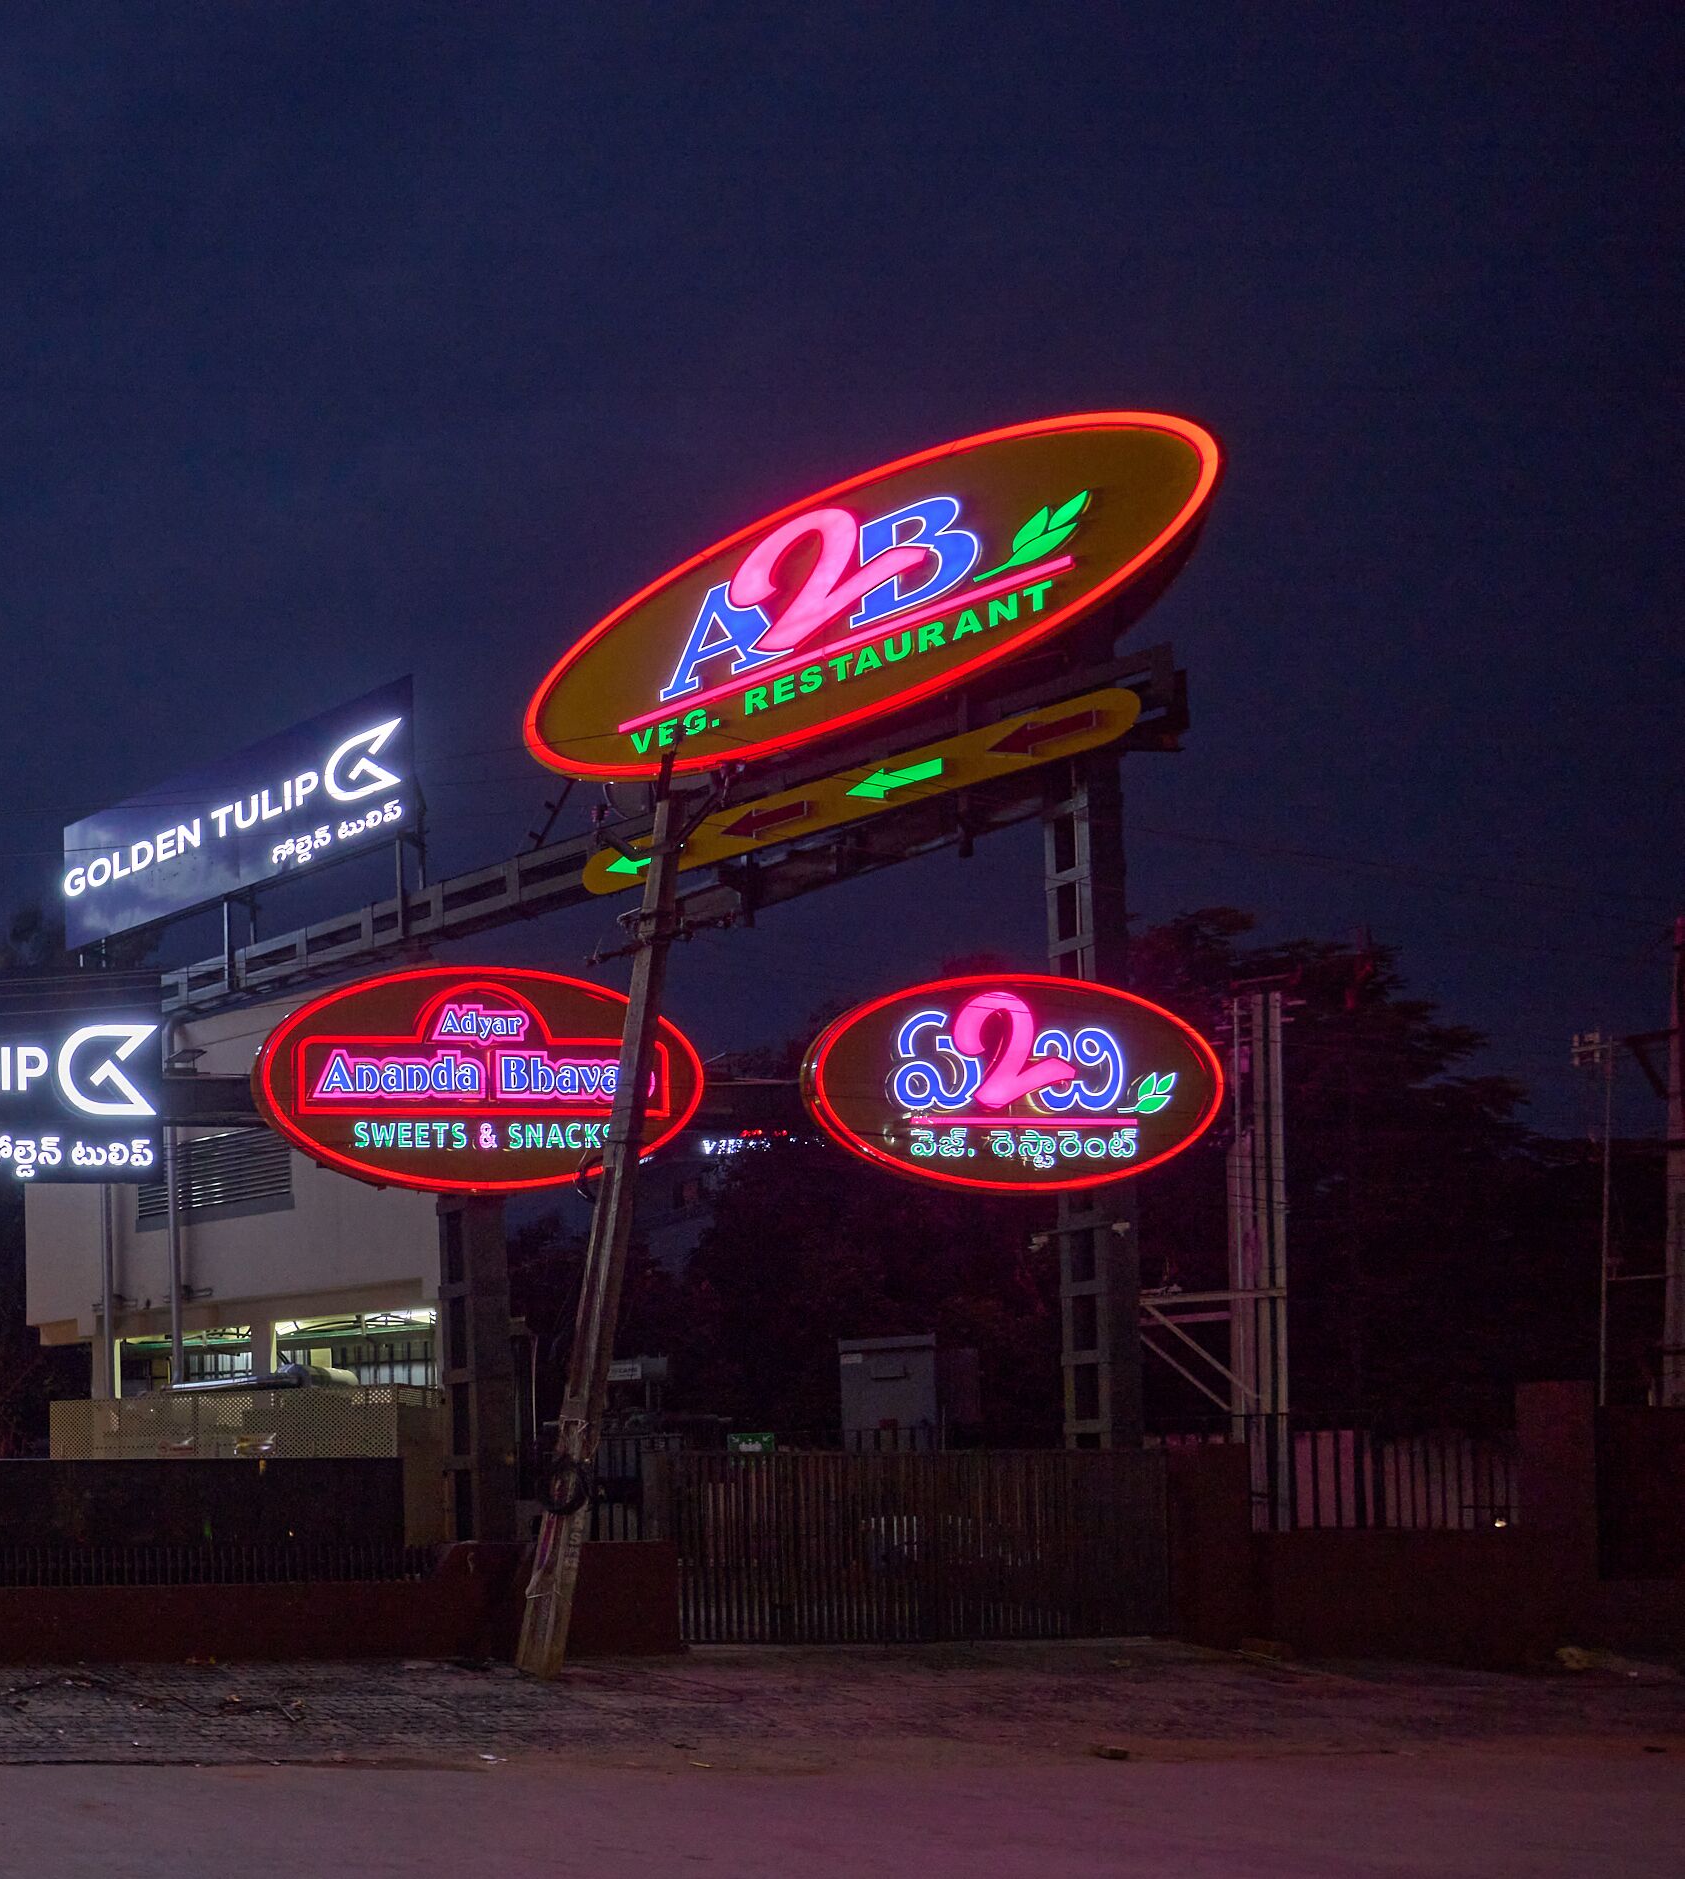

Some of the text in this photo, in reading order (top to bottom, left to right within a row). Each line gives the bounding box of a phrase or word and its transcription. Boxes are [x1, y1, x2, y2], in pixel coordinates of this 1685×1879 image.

[659, 495, 981, 702] A2B
[630, 580, 1053, 754] VEG. RESTAURANT
[63, 771, 319, 896] GOLDEN TULIP
[271, 800, 402, 864] గోల్డెన్ టులిప్
[439, 1009, 524, 1039] Adyar
[322, 1055, 620, 1095] Ananda Bhava
[71, 1138, 154, 1167] టులిప్
[353, 1121, 467, 1149] SWEETS
[478, 1122, 498, 1149] &
